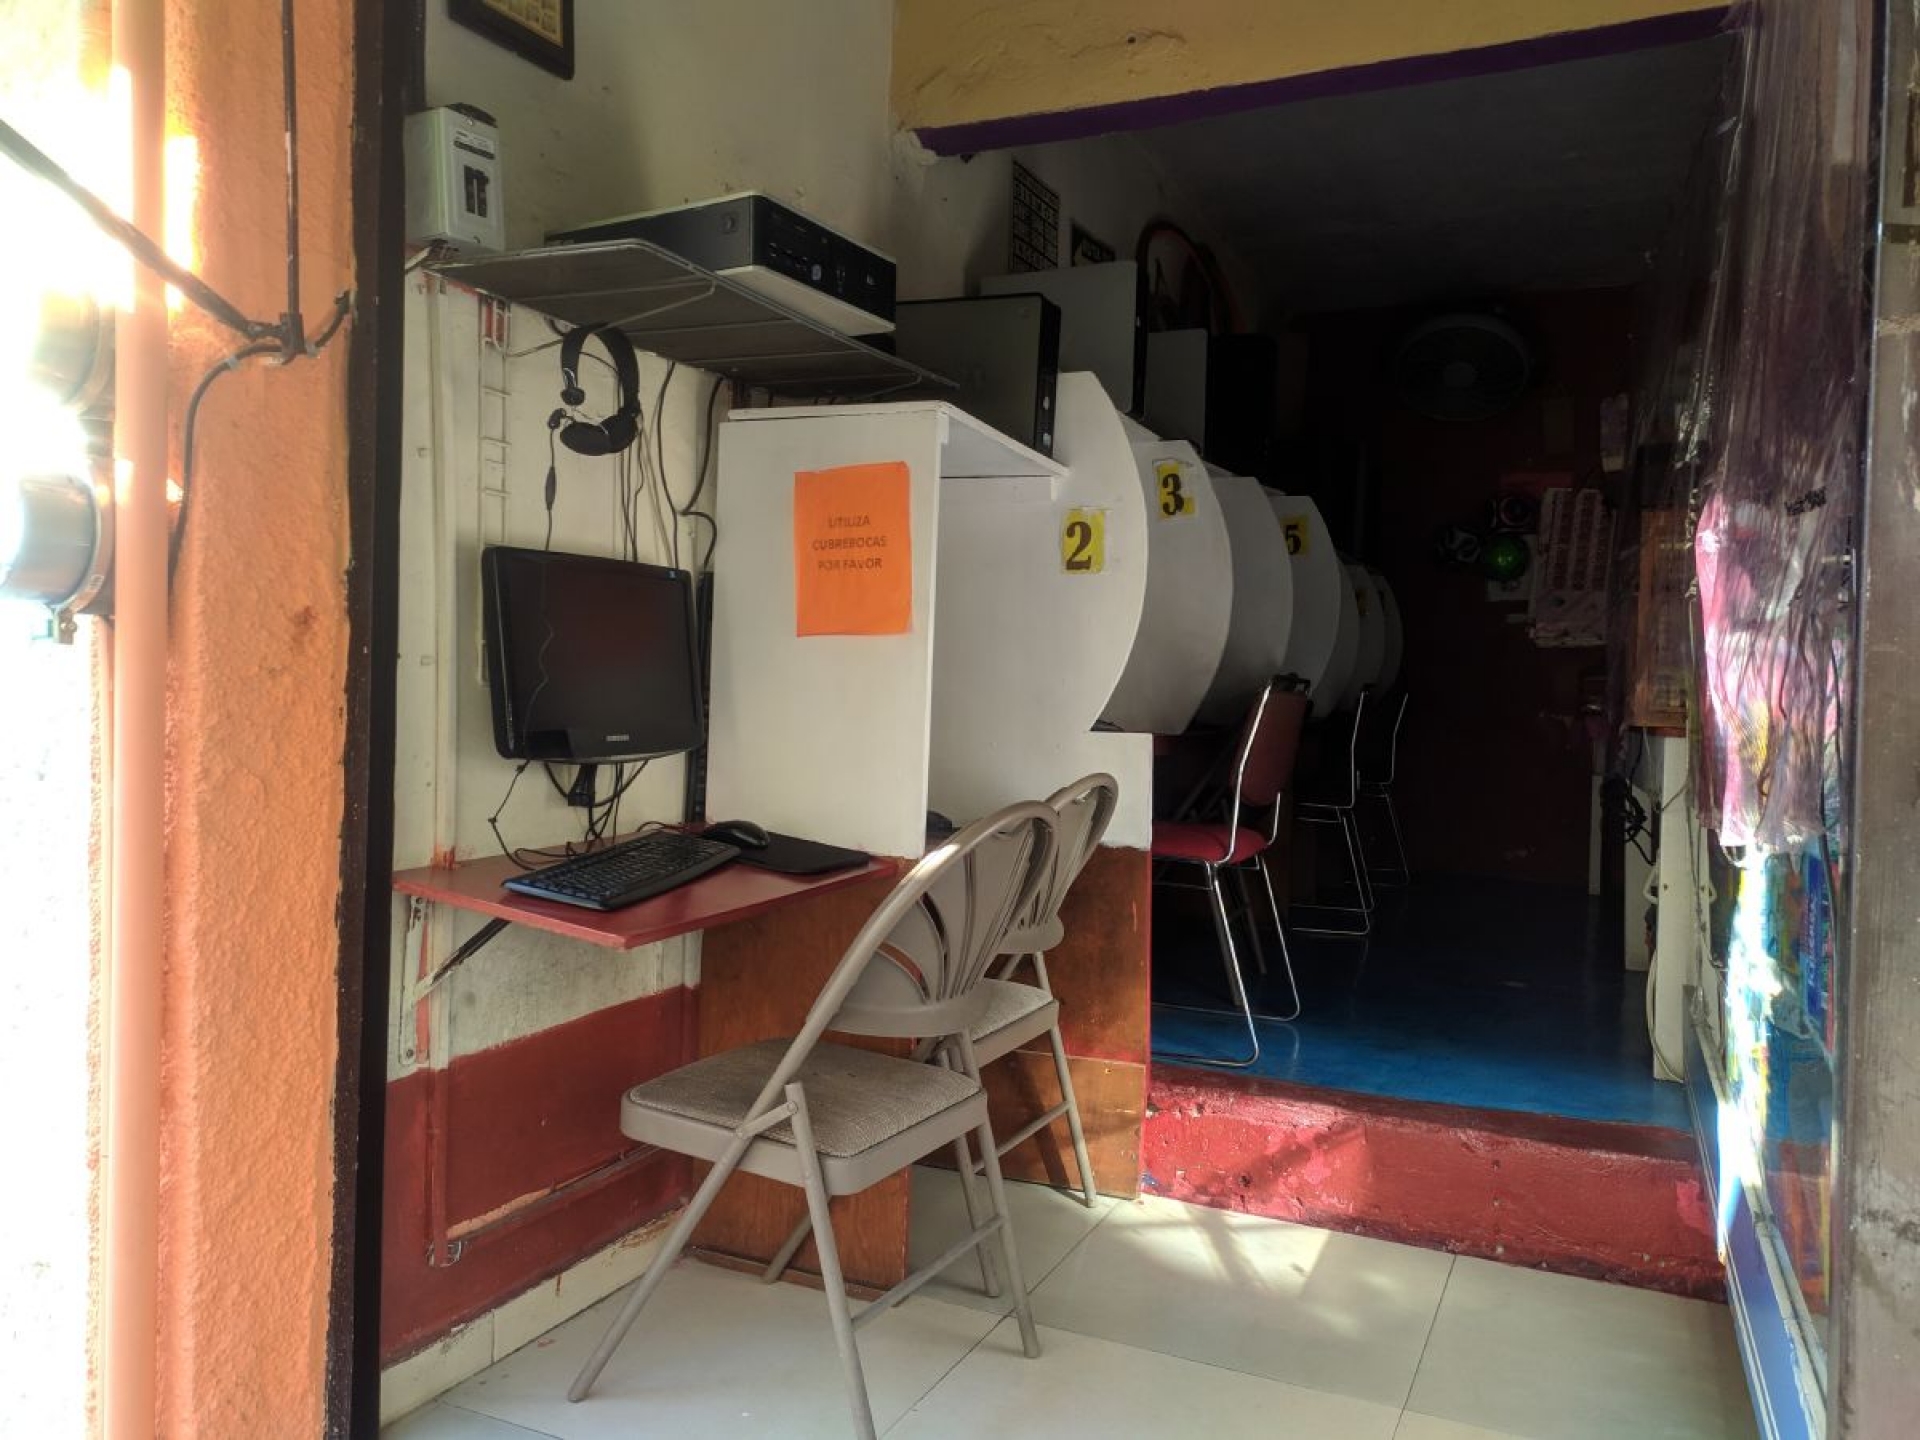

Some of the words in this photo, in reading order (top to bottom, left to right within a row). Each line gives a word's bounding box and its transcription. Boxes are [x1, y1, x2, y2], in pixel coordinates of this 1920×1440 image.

[1162, 473, 1184, 515] 3
[828, 514, 871, 528] UTILIZA
[812, 535, 888, 551] CUBREBOCAS
[1066, 521, 1092, 570] 2
[1286, 524, 1301, 555] 5
[818, 559, 841, 571] POR
[843, 557, 883, 570] FAVOR
